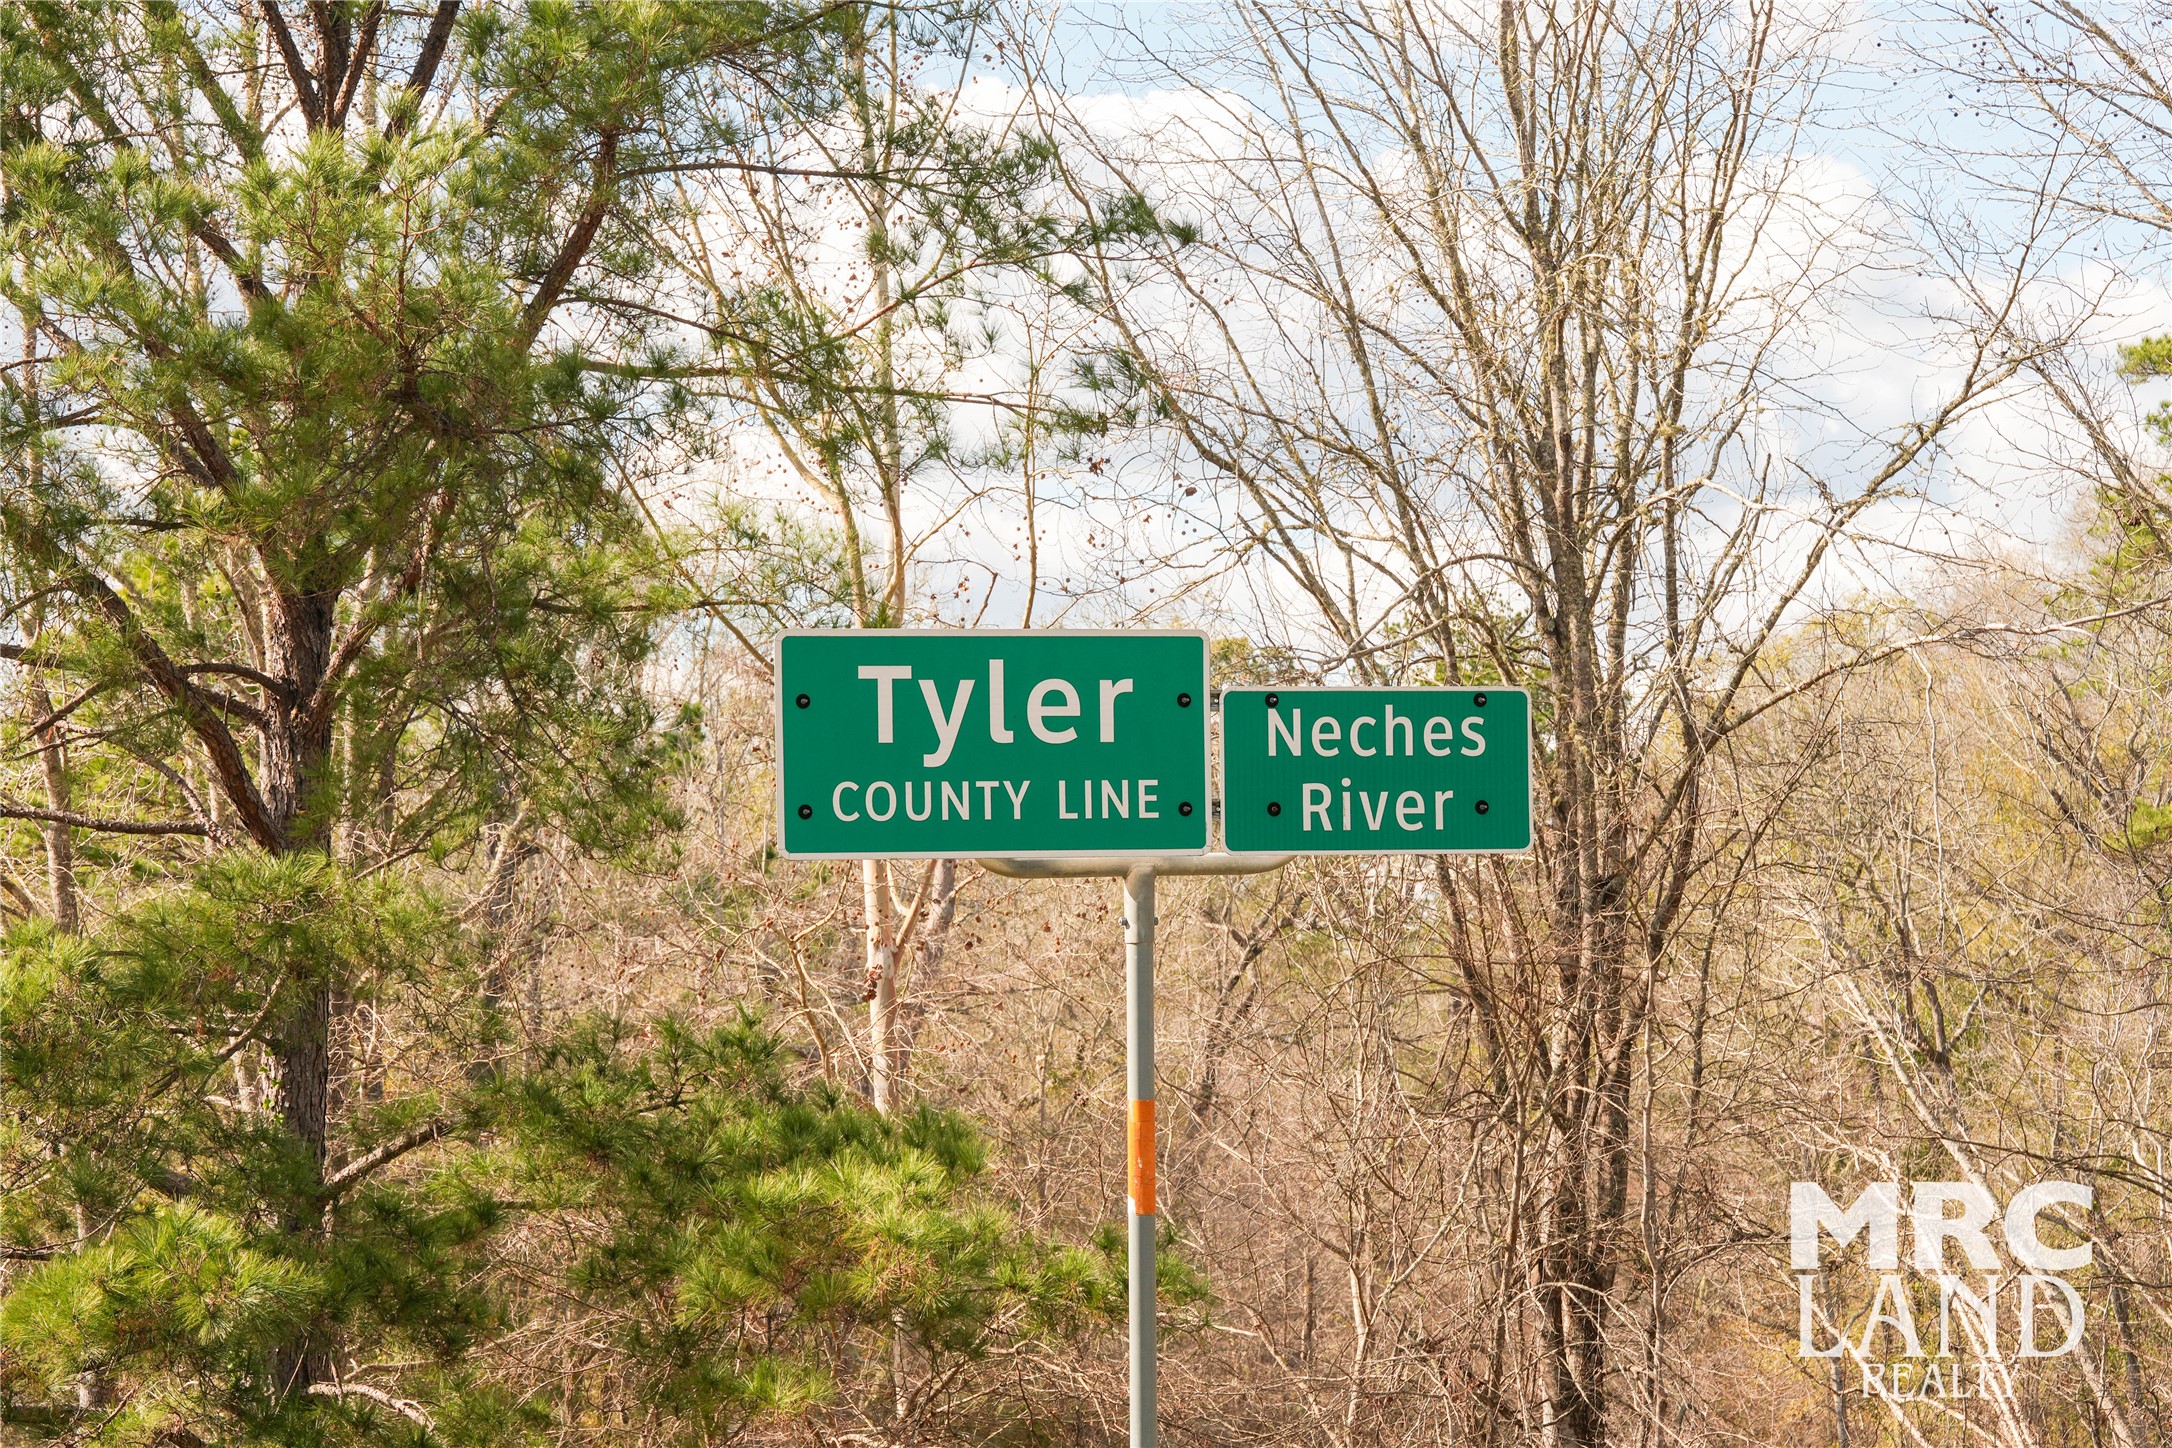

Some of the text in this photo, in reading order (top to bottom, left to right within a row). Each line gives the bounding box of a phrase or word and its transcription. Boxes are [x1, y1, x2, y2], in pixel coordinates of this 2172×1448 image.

[857, 658, 1134, 768] Tyler
[1267, 704, 1487, 758] Neches
[832, 779, 1160, 823] COUNTY LINE
[1301, 777, 1454, 832] River
